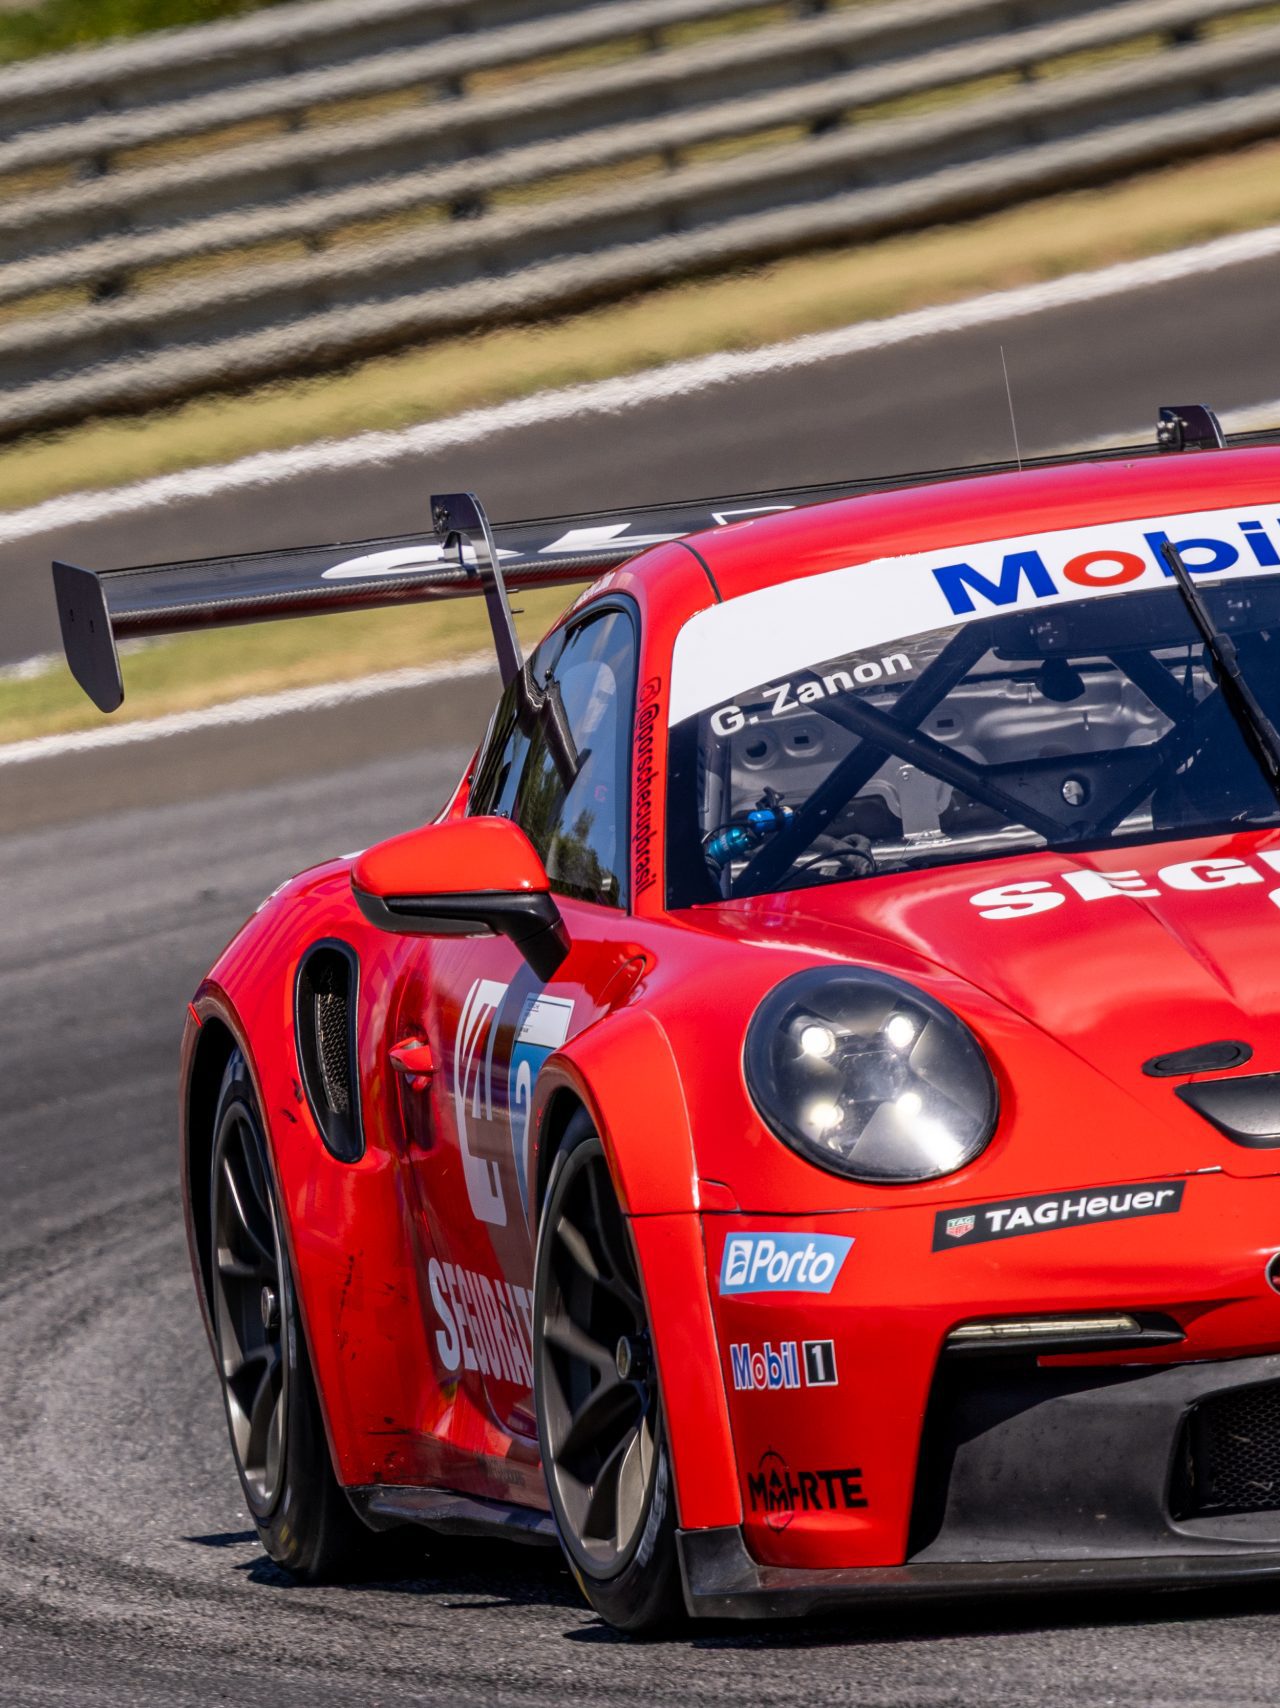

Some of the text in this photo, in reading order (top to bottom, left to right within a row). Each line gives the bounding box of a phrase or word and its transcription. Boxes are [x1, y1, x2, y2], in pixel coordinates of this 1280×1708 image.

[709, 650, 913, 738] G. Zanon
[428, 1257, 534, 1389] SEGURALT
[729, 1341, 800, 1390] Mobil
